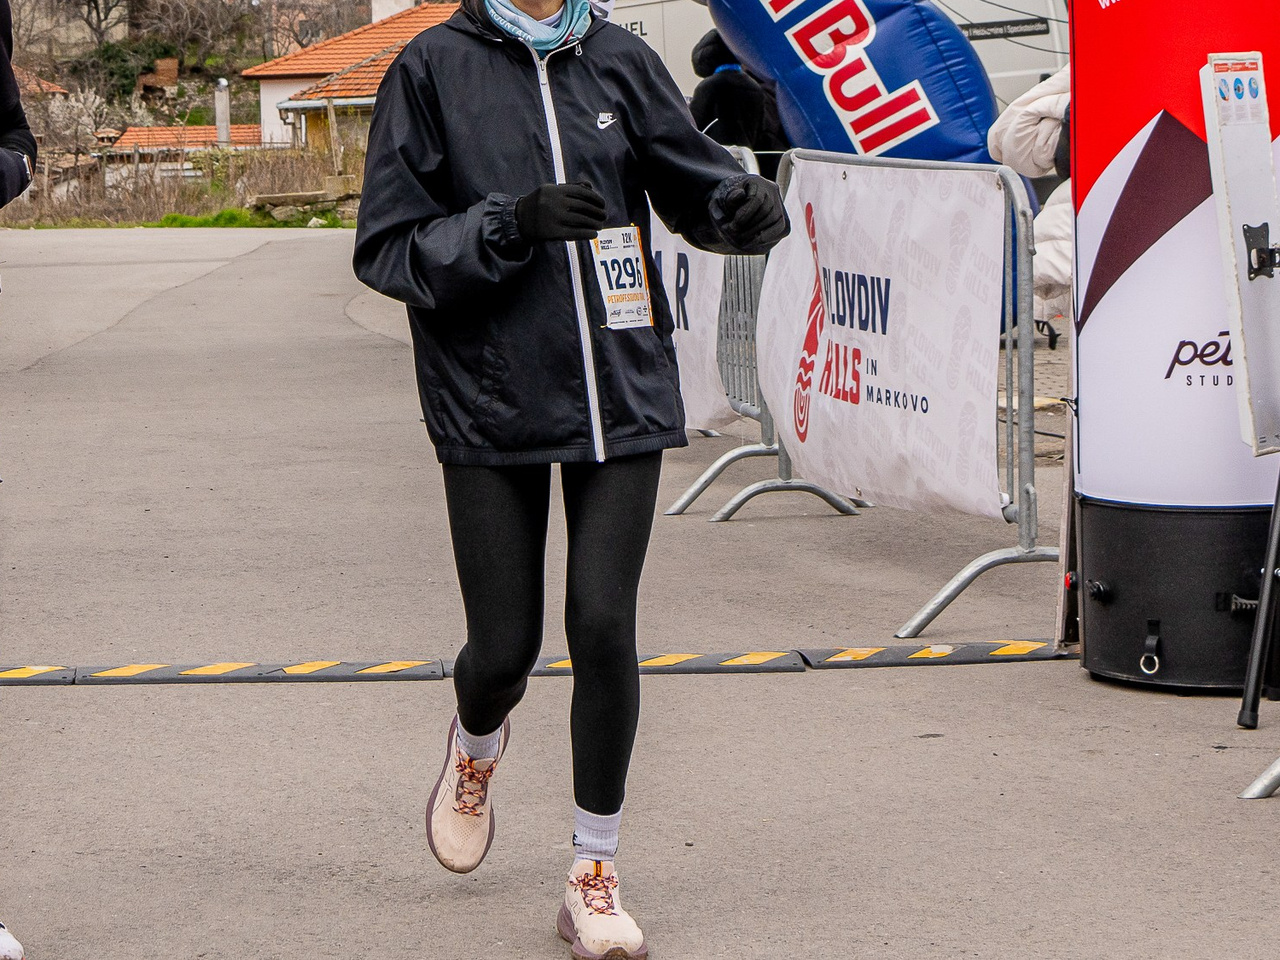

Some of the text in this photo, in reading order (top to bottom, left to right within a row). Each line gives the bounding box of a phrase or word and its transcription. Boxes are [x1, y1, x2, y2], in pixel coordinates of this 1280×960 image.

[600, 257, 643, 291] 1296
[823, 267, 891, 335] PLOVDIV
[866, 358, 877, 376] IN
[866, 385, 929, 414] MARKOVO
